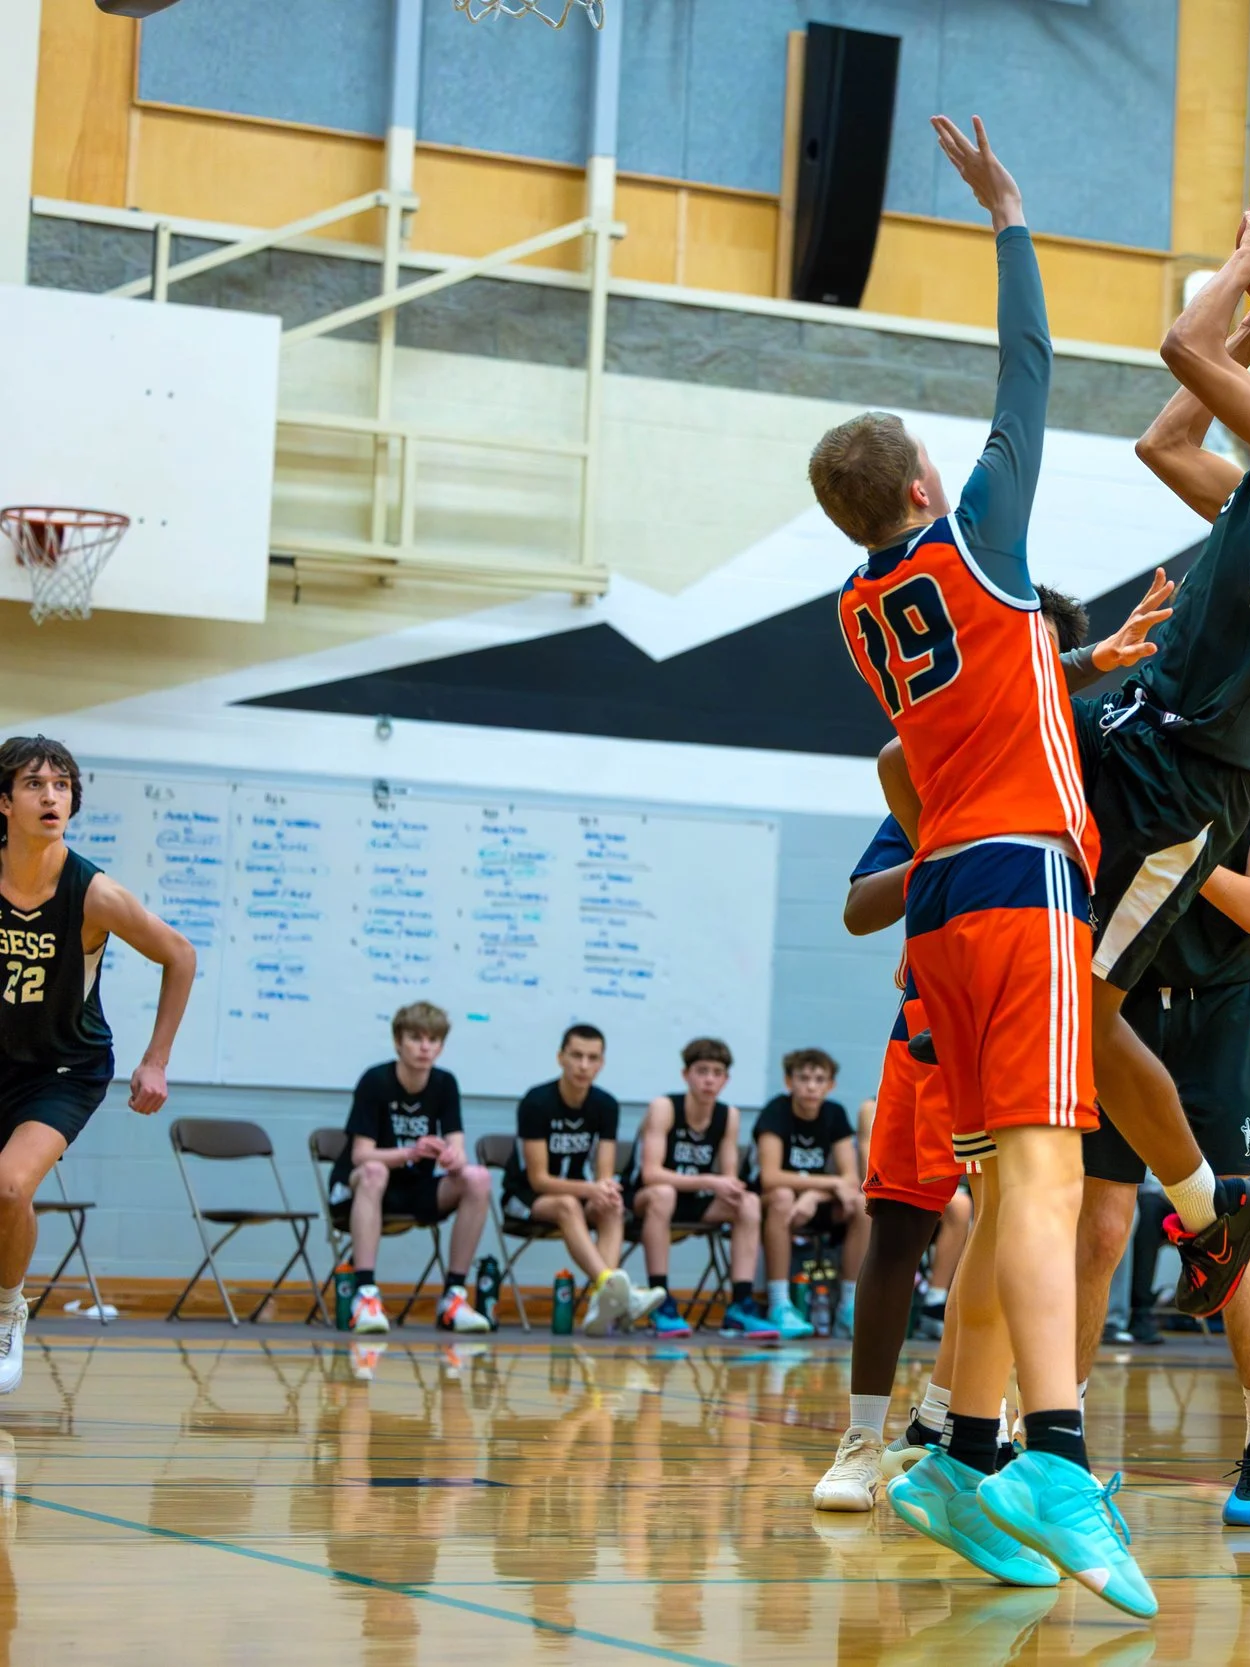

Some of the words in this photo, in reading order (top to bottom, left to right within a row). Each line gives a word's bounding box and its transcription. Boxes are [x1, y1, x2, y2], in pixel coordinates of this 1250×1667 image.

[853, 573, 963, 720] 19
[0, 928, 56, 960] GESS
[4, 961, 46, 1004] 22
[549, 1132, 591, 1153] GESS
[674, 1141, 714, 1166] GESS
